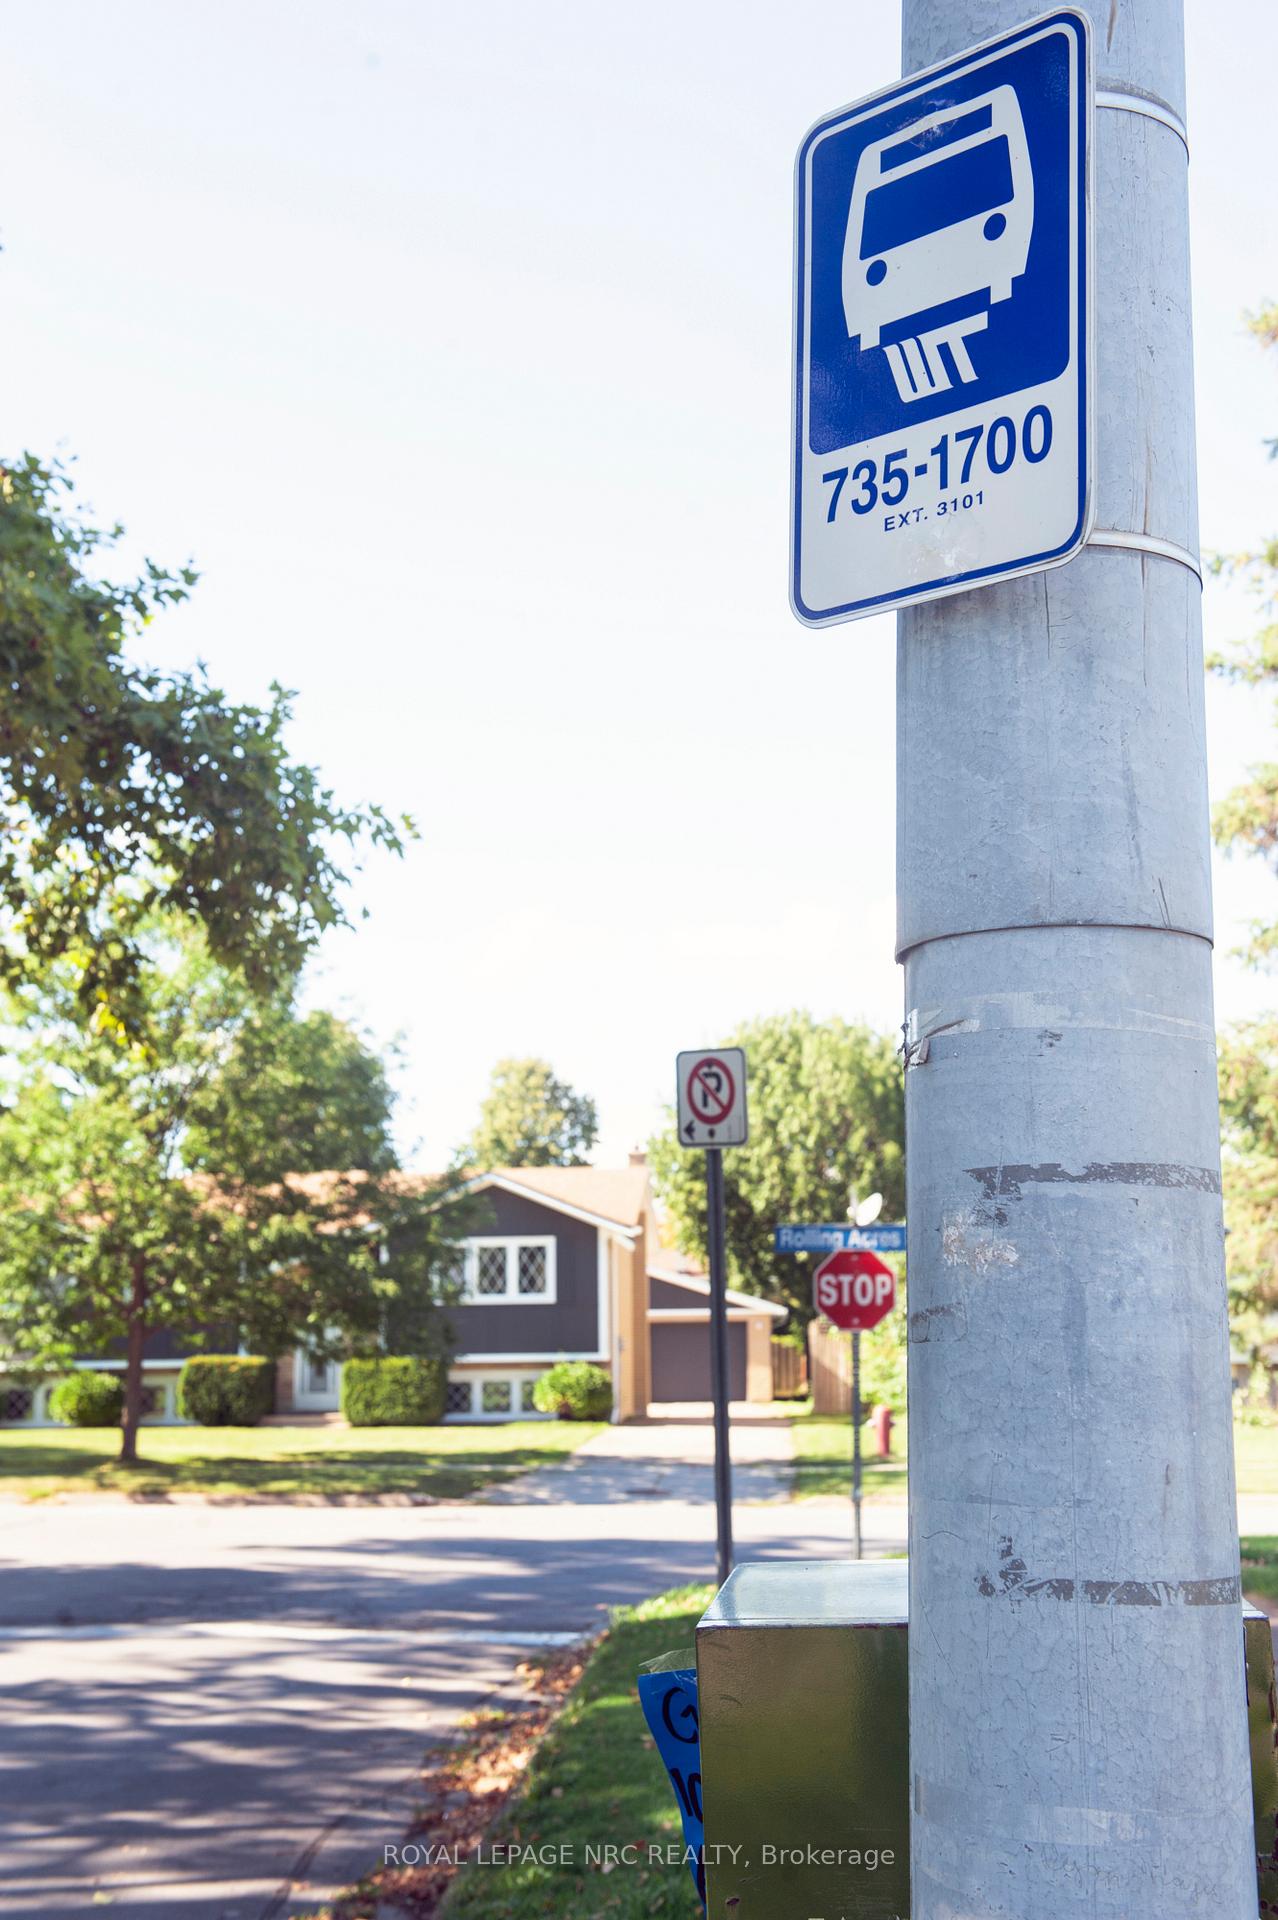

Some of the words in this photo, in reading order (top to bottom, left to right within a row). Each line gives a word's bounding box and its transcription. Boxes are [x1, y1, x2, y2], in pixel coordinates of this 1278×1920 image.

[822, 404, 1053, 524] 735-1700
[884, 507, 929, 532] EXT.
[937, 491, 985, 516] 3101
[819, 1273, 892, 1307] STOP
